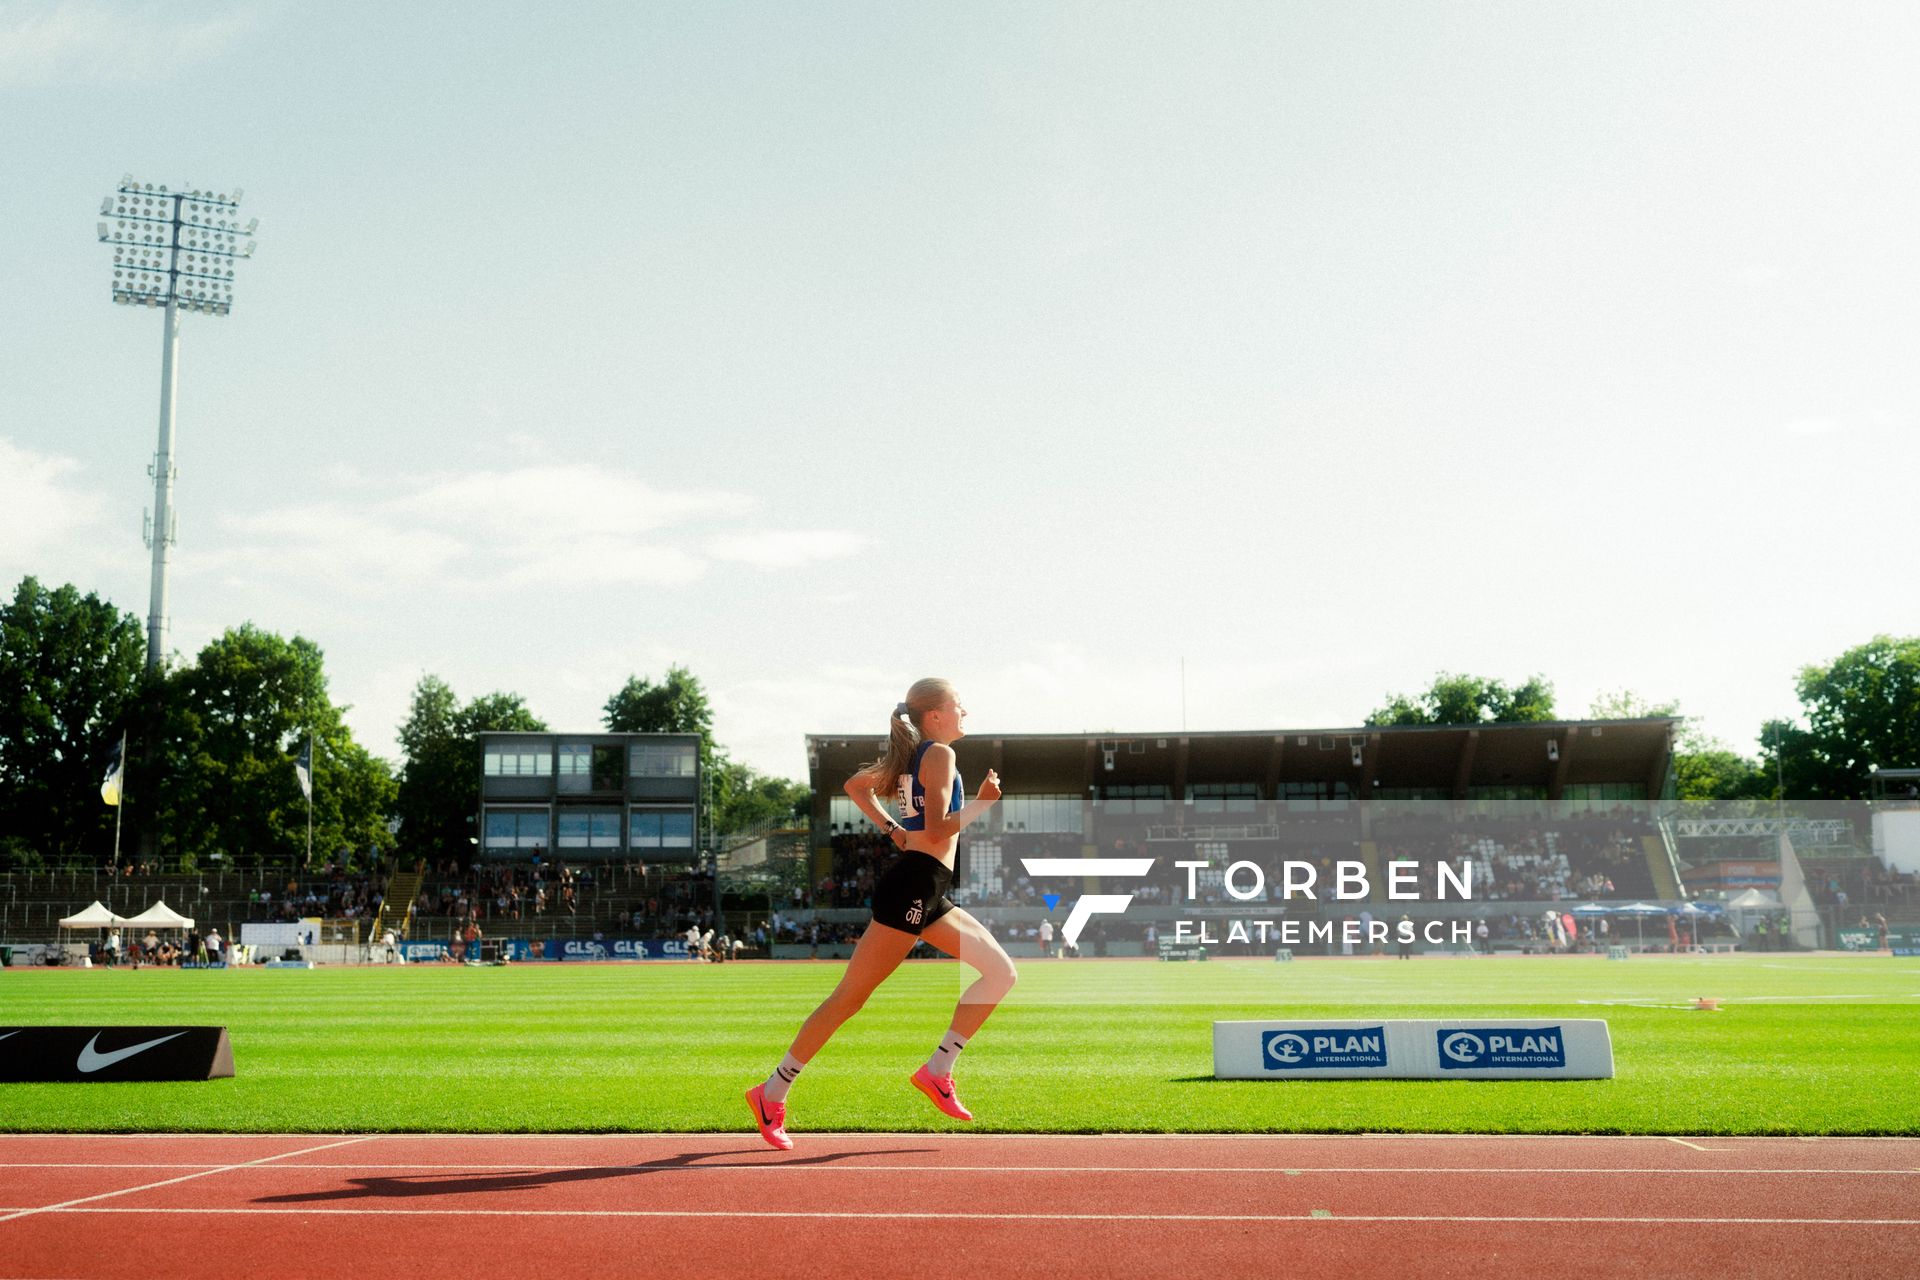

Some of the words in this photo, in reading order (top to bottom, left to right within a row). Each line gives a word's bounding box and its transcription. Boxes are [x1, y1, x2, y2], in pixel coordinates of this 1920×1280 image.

[565, 941, 595, 954] GLS
[1314, 1036, 1380, 1053] PLAN
[1489, 1036, 1558, 1053] PLAN
